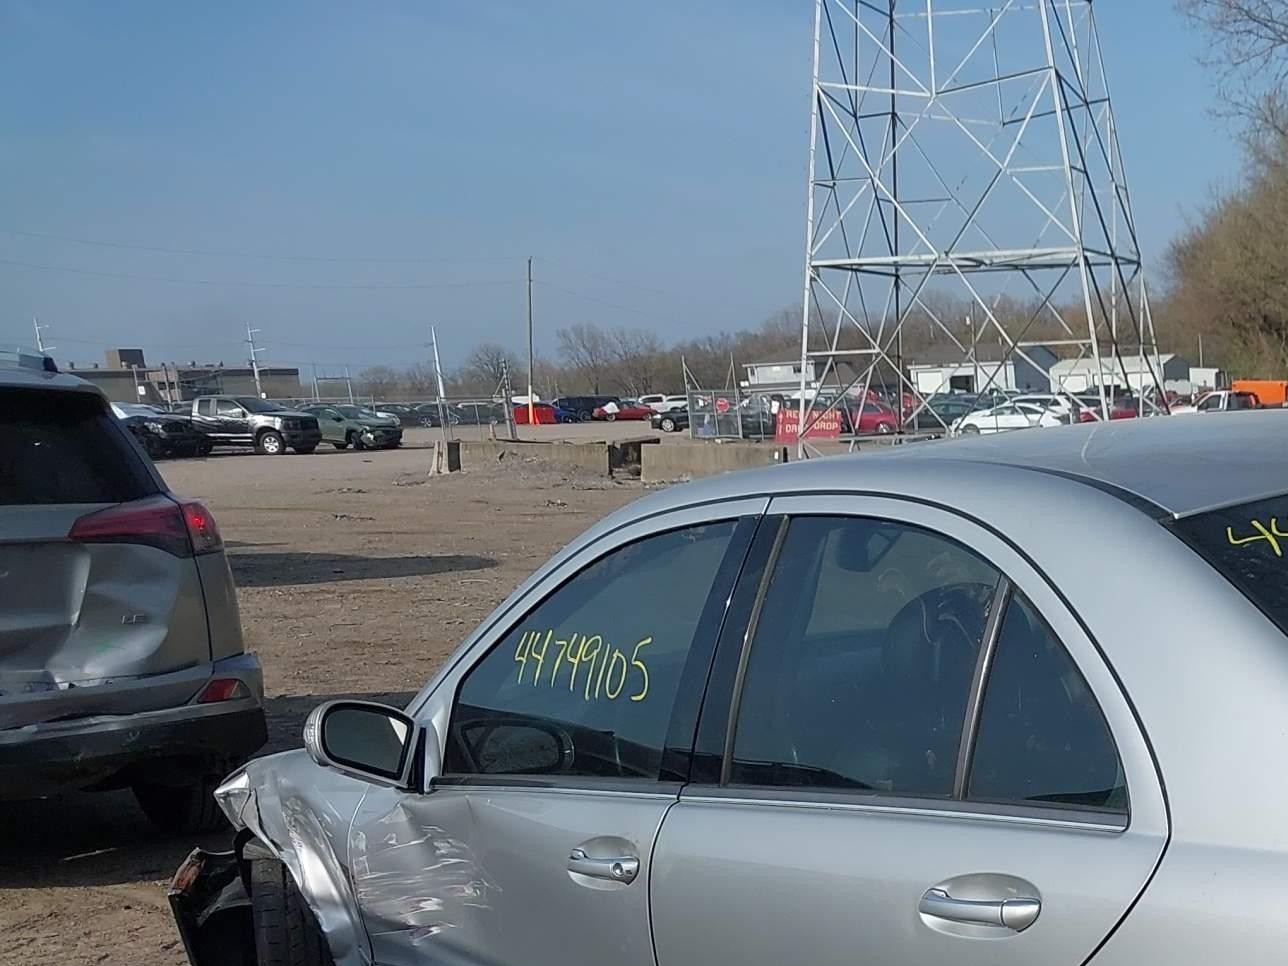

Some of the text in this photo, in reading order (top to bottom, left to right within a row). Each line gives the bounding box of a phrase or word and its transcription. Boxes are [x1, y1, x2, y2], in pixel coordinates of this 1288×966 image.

[785, 409, 804, 419] RE
[785, 423, 809, 433] DR
[814, 421, 839, 430] DROP
[514, 629, 653, 701] 44749105
